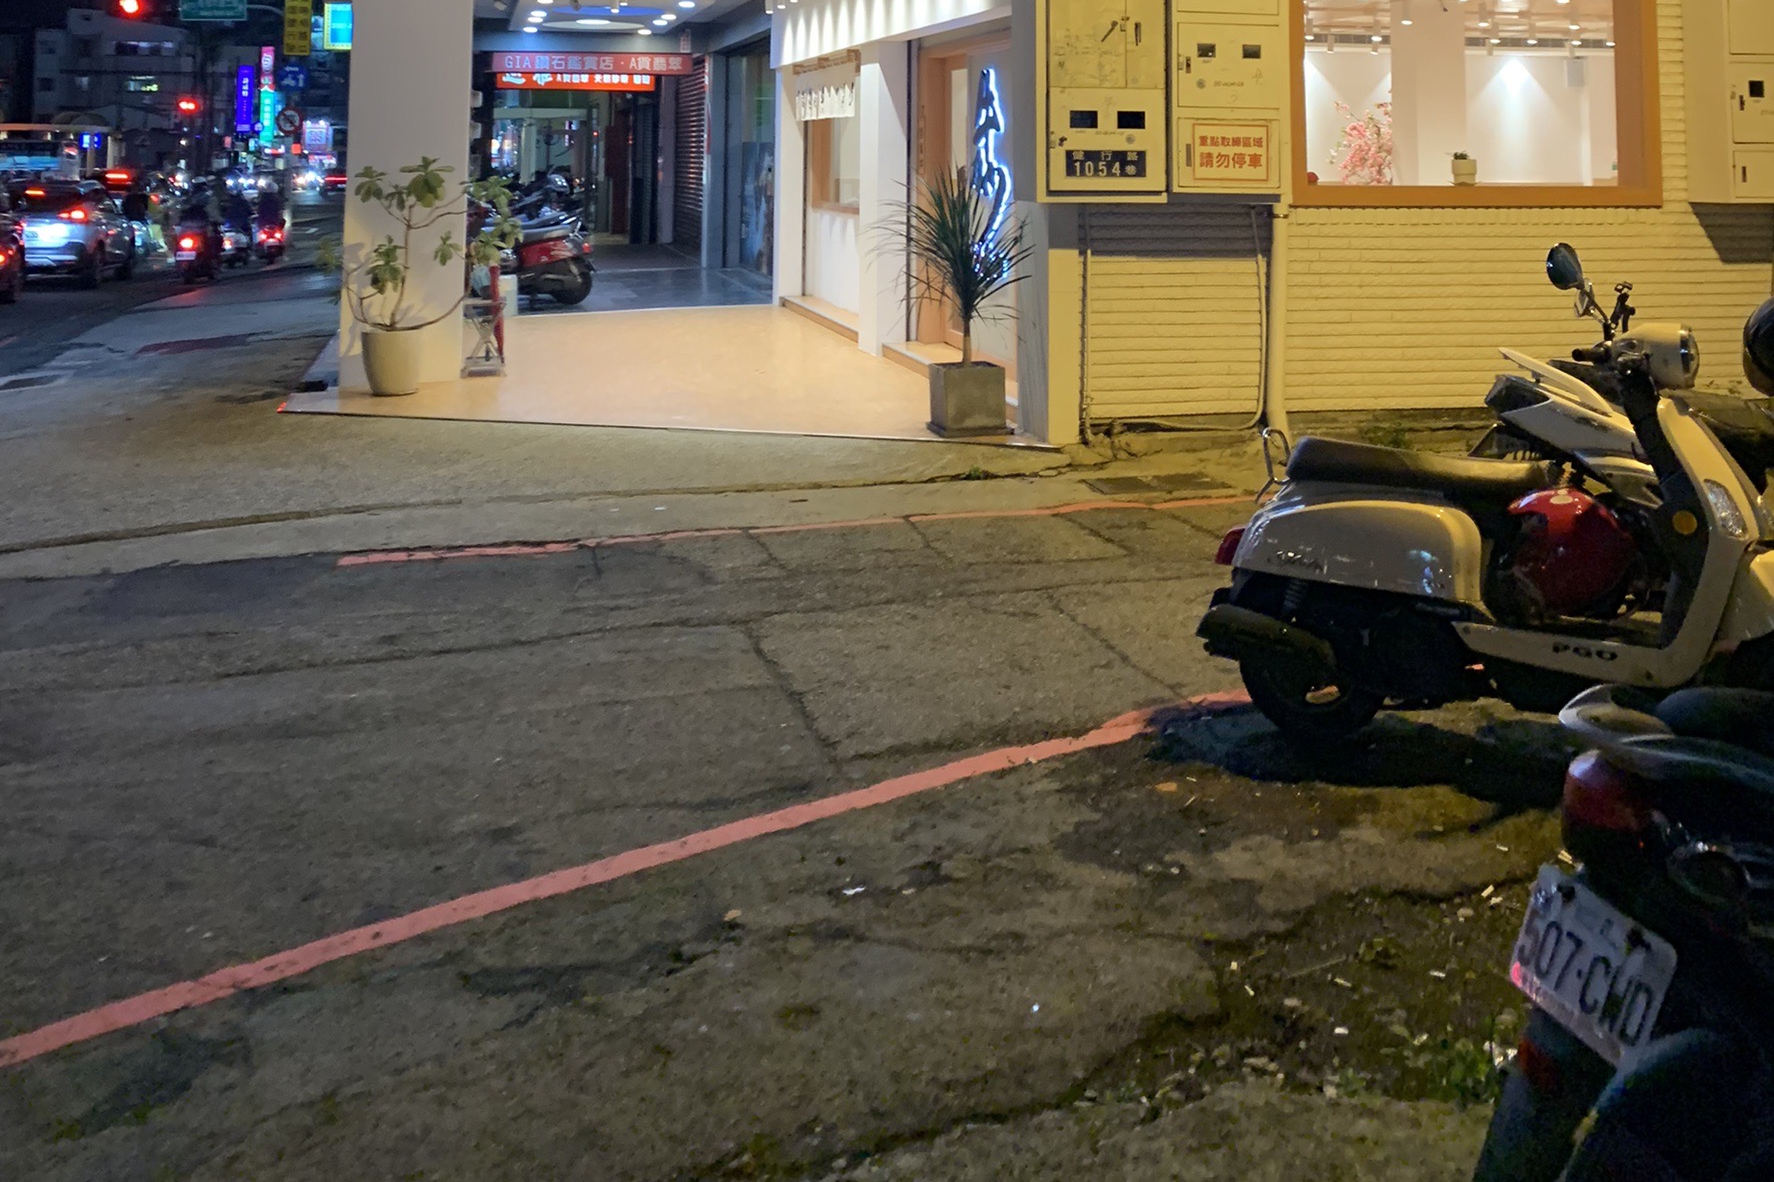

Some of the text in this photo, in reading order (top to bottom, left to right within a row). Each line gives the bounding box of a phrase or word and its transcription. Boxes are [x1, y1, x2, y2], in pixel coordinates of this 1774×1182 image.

[1198, 135, 1264, 149] 重點取締區域
[1198, 152, 1264, 169] 請勿停車
[1552, 641, 1618, 661] PGO
